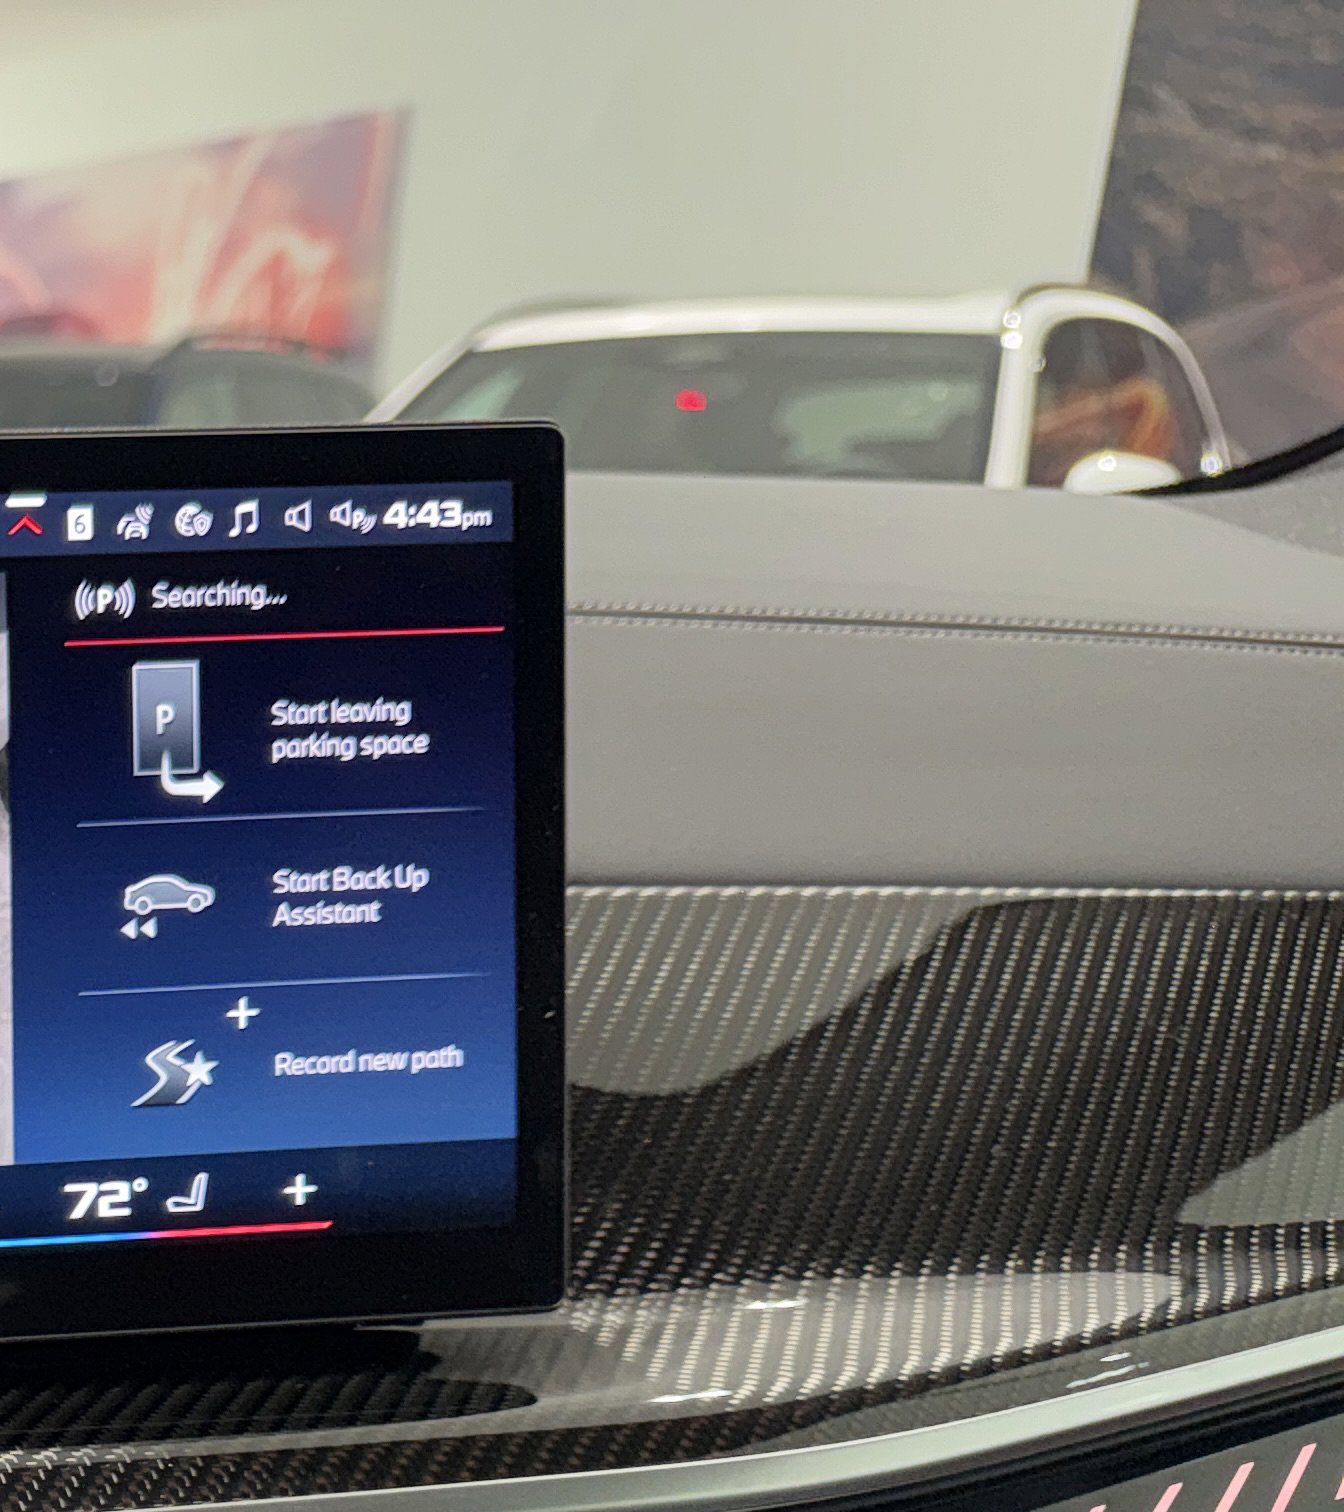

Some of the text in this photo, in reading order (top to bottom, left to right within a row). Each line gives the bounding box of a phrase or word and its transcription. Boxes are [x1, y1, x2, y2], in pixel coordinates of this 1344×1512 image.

[151, 578, 288, 611] Searching...
[271, 696, 412, 727] Start leaving
[271, 731, 431, 764] parking space
[272, 862, 431, 894] Start Back Up
[272, 899, 382, 927] Assistant
[273, 1043, 465, 1077] Record new path
